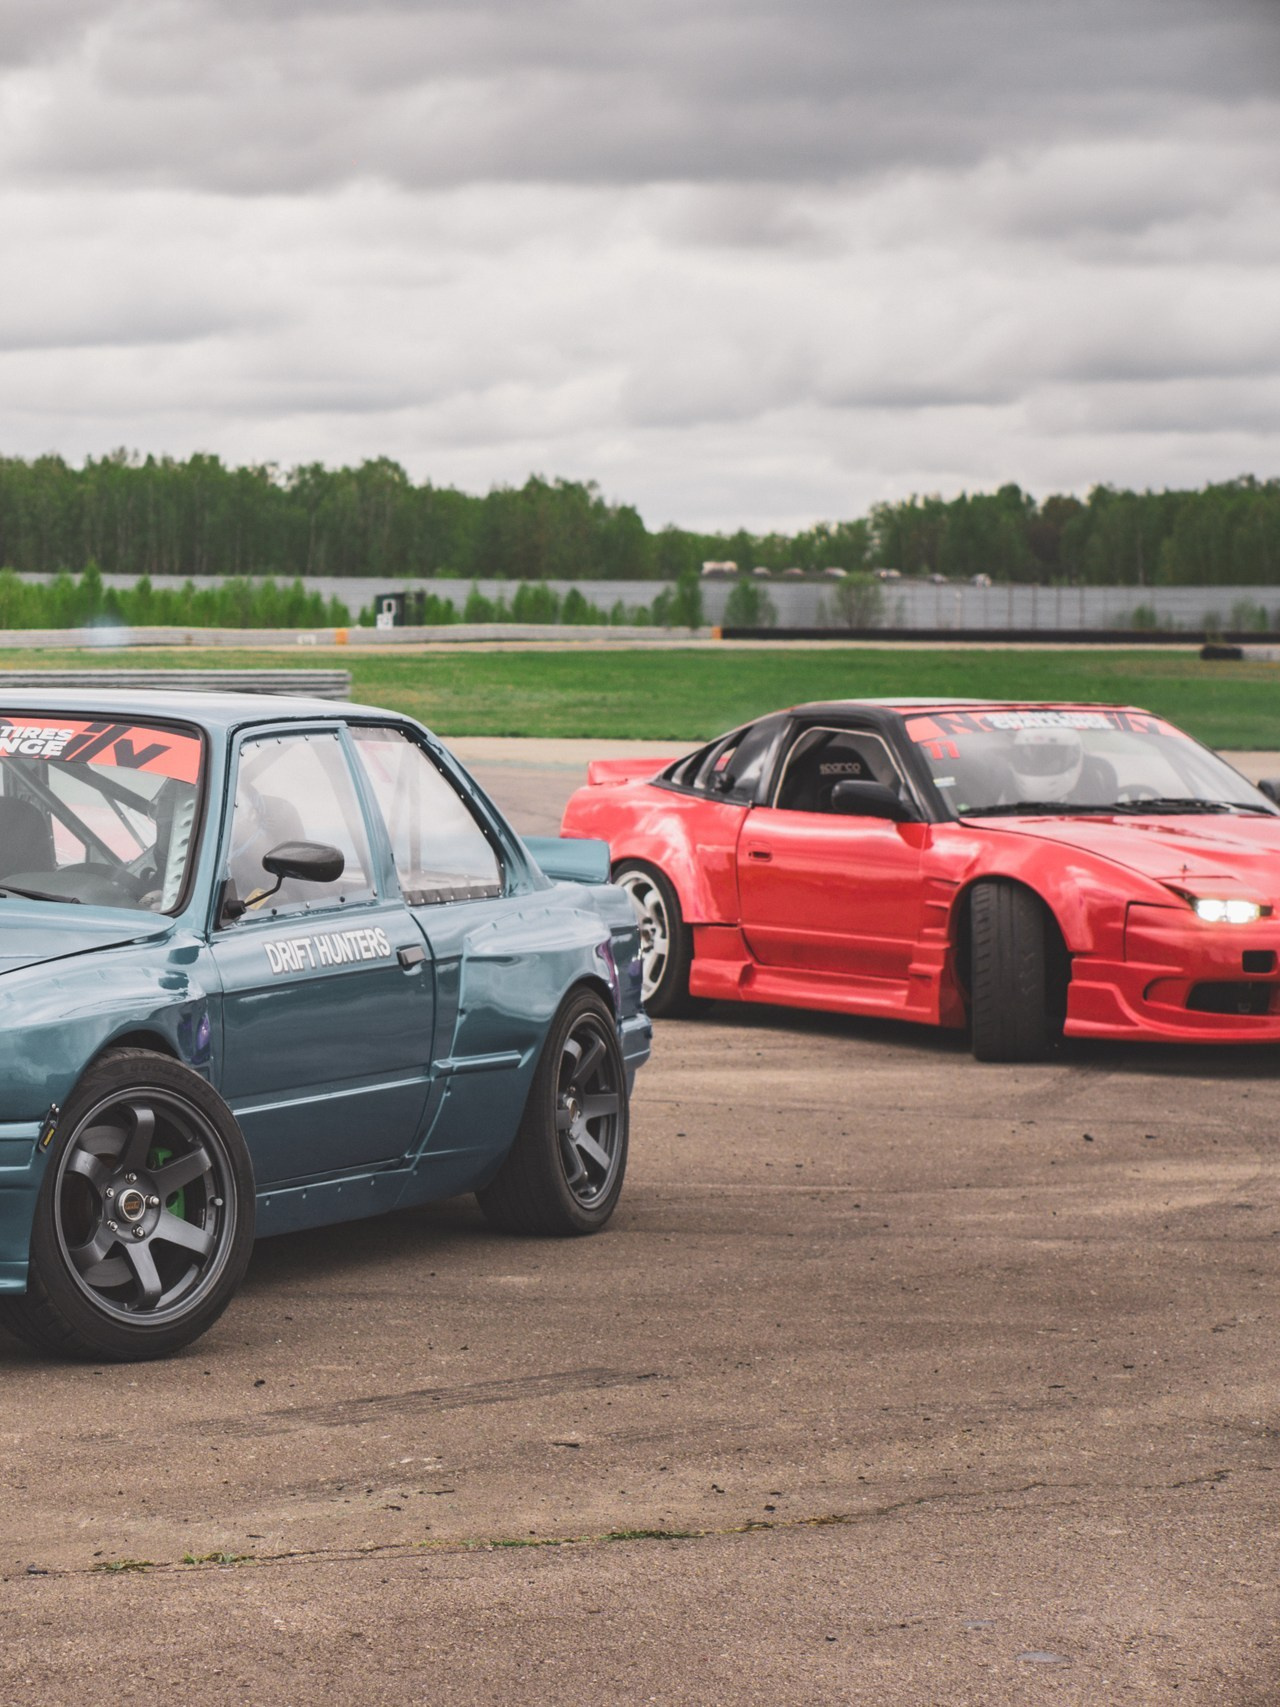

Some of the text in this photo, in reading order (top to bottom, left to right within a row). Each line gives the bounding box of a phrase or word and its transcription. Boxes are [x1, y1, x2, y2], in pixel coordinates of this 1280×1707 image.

[0, 725, 75, 741] TIRES
[922, 741, 960, 760] 11
[263, 927, 391, 974] DRIFT HUNTERS
